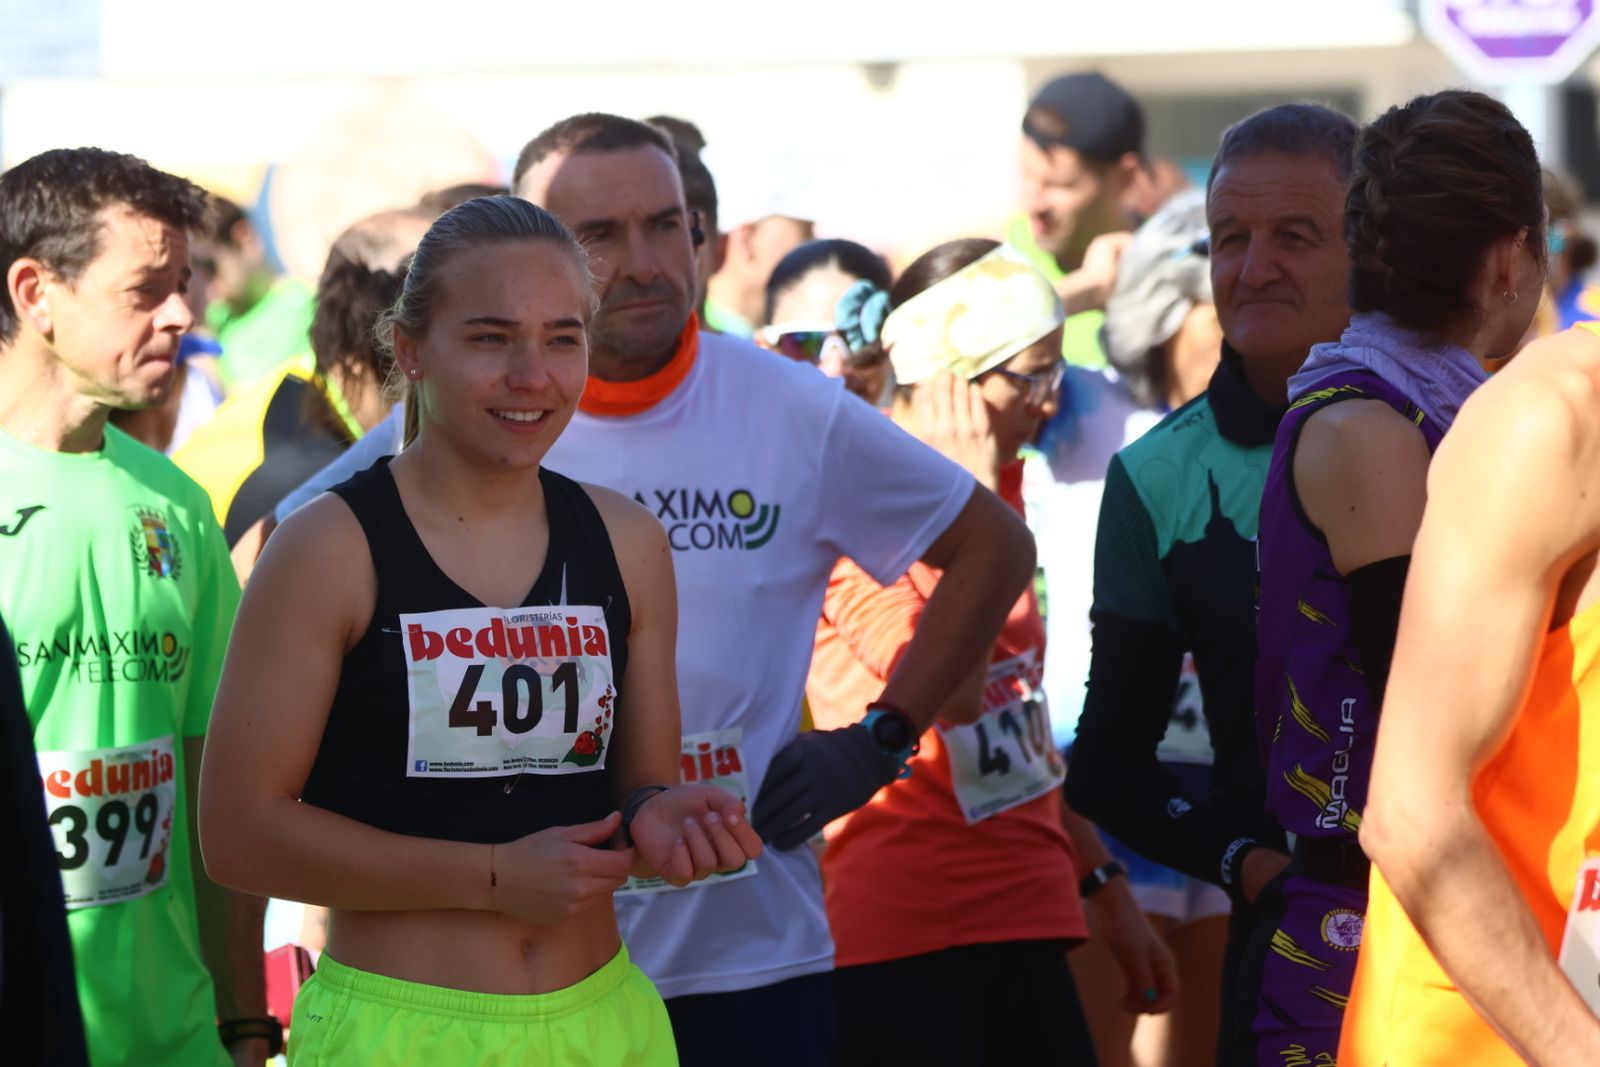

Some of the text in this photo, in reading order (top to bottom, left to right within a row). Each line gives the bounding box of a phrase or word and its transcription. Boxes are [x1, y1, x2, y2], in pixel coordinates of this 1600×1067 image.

[17, 630, 178, 668] SANMAXIMO
[407, 616, 608, 662] bedunia
[448, 662, 579, 736] 401
[41, 749, 174, 800] edunia
[974, 699, 1047, 777] 410
[1315, 697, 1357, 829] MAGLIA
[48, 792, 158, 871] 399
